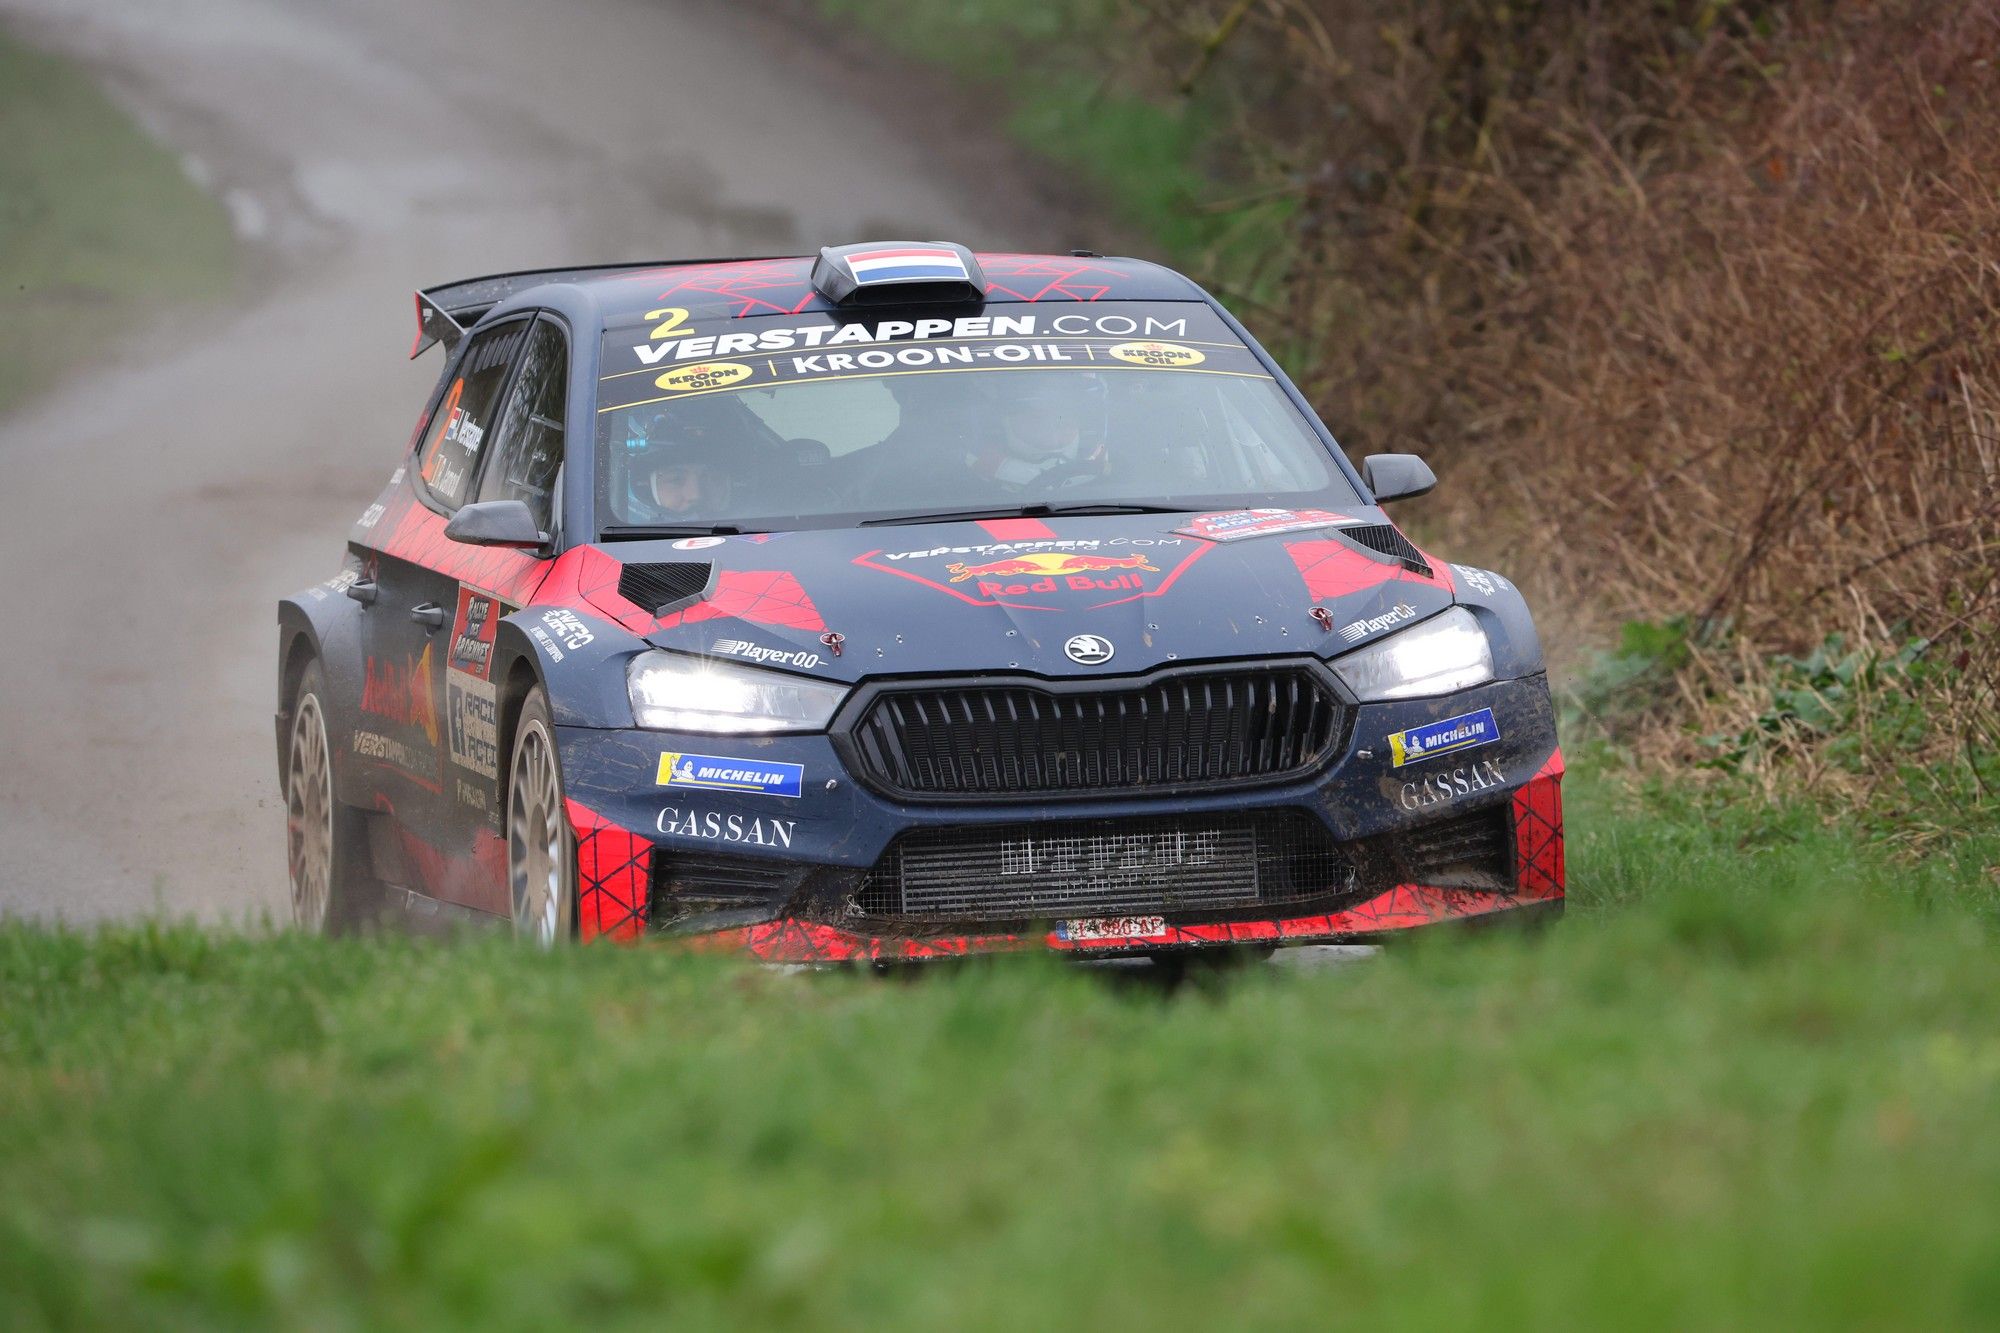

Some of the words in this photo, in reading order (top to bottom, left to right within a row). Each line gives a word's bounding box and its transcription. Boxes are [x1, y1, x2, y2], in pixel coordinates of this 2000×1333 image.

[644, 308, 696, 339] 2
[633, 315, 1187, 365] VERSTAPPEN.COM
[792, 344, 1073, 374] KROON-OIL
[1122, 350, 1192, 359] KROON
[1144, 356, 1175, 365] OIL
[668, 368, 739, 385] KROON
[690, 378, 722, 389] OIL
[885, 537, 1182, 561] VERSTAPPEN.COM
[982, 545, 1099, 556] RACING
[976, 575, 1057, 597] Red
[1065, 573, 1142, 591] Bull
[1425, 721, 1485, 748] MICHELIN
[697, 766, 785, 785] MICHELIN
[1400, 757, 1506, 810] GASSAN
[656, 806, 797, 849] GASSAN
